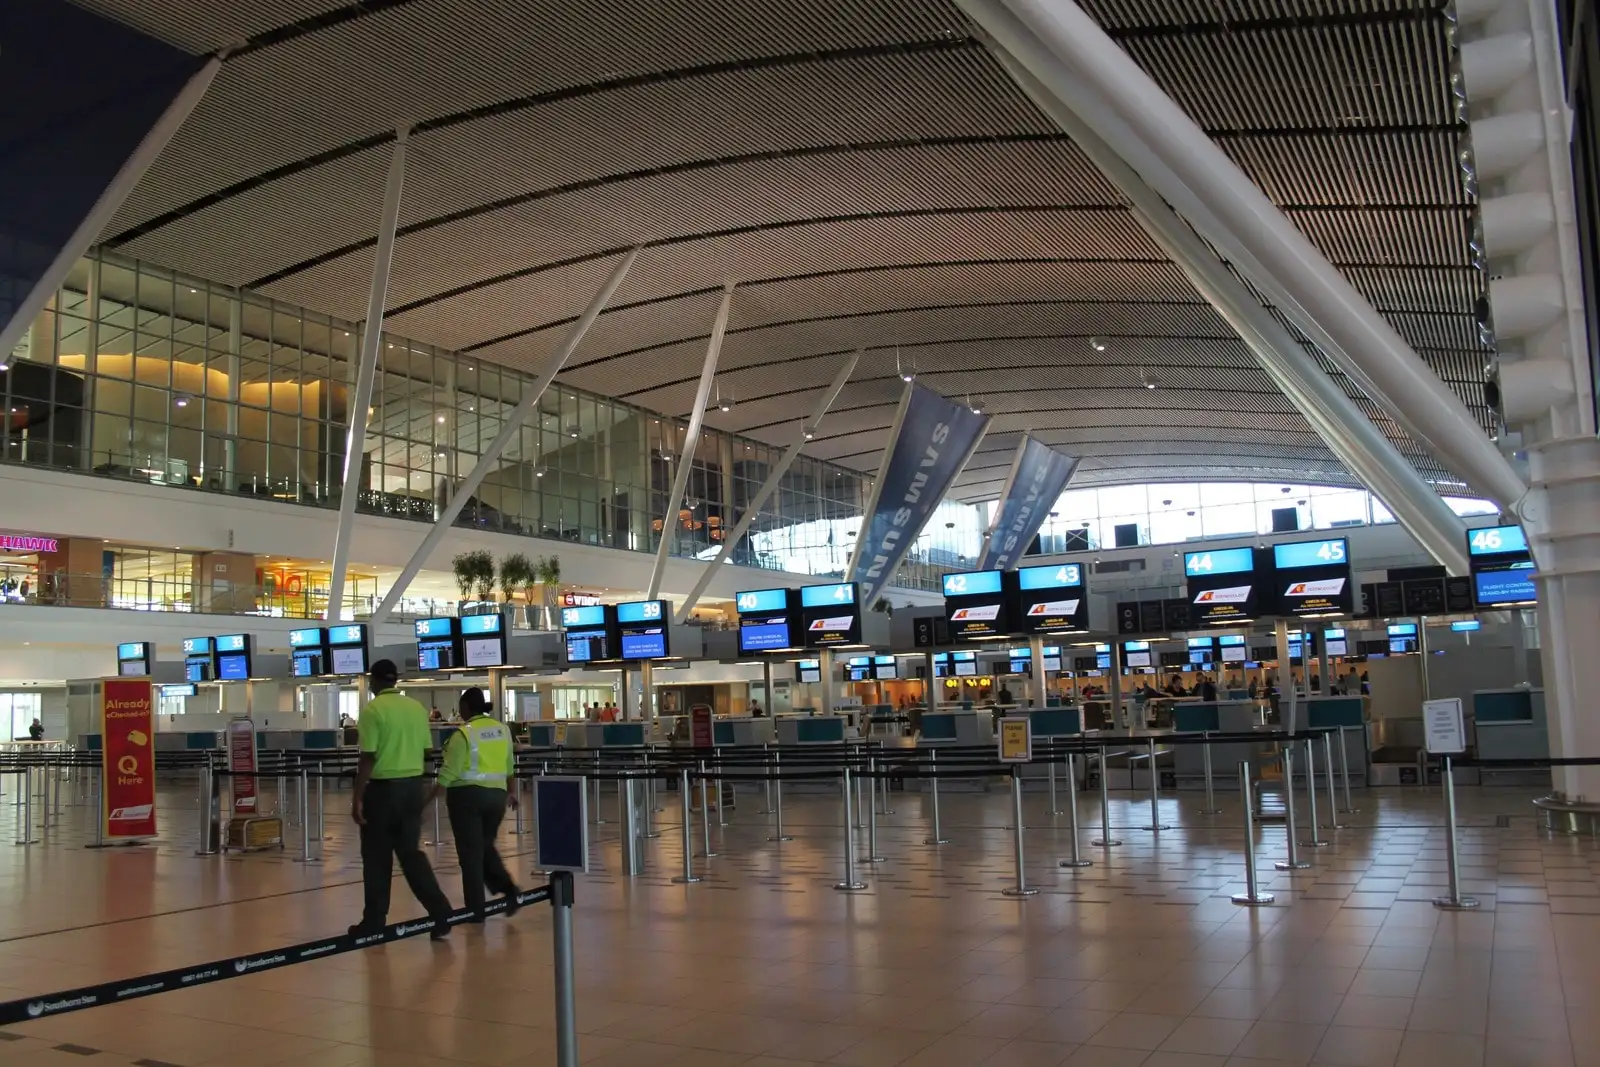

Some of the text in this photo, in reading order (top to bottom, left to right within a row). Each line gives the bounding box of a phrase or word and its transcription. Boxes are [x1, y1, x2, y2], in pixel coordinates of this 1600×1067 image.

[0, 535, 57, 552] HAWK
[1472, 529, 1502, 550] 46
[1316, 541, 1344, 560] 45
[1186, 553, 1213, 571] 44
[1055, 566, 1079, 583] 43
[945, 575, 966, 592] 42
[834, 585, 853, 601] 41
[738, 593, 757, 609] 40
[563, 609, 579, 624] 38
[643, 603, 661, 617] 39
[415, 620, 430, 635] 36
[483, 615, 497, 630] 37
[290, 631, 303, 645] 34
[348, 626, 361, 639] 35
[183, 640, 193, 652] 32
[232, 635, 243, 648] 33
[133, 643, 143, 656] 31
[106, 698, 150, 710] Already
[118, 755, 139, 776] Q
[118, 776, 143, 786] Here
[247, 954, 286, 969] Southern Sun
[44, 994, 97, 1012] Southern Sun
